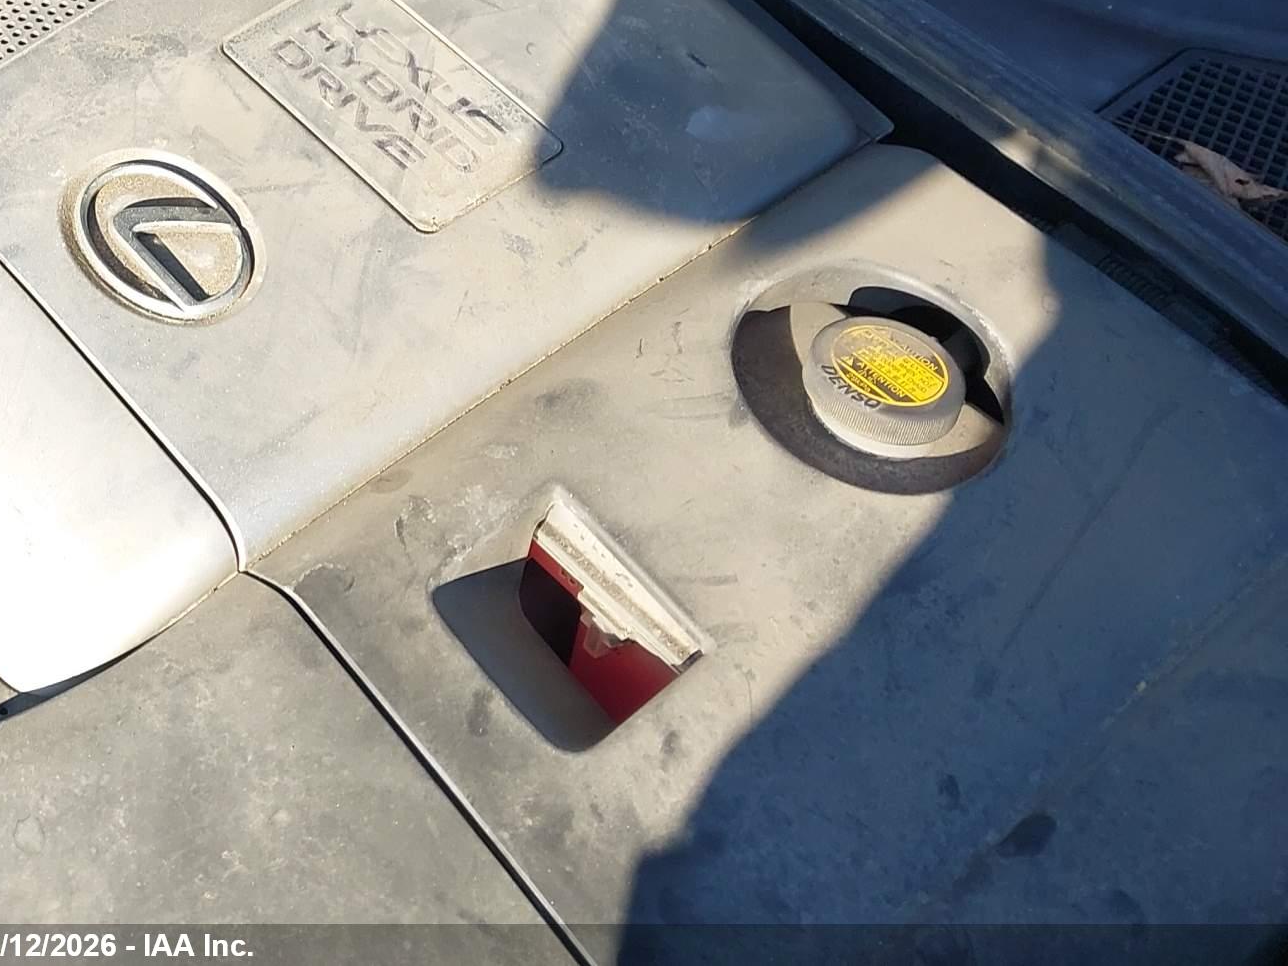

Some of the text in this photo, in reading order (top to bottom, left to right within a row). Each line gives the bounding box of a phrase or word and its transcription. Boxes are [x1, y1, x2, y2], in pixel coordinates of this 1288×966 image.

[272, 38, 427, 171] DRIVE
[306, 22, 480, 174] HYBRID
[336, 2, 507, 147] LEXUS
[821, 364, 881, 409] DENSO
[857, 359, 906, 398] ATTENTION
[893, 339, 939, 371] AUTION
